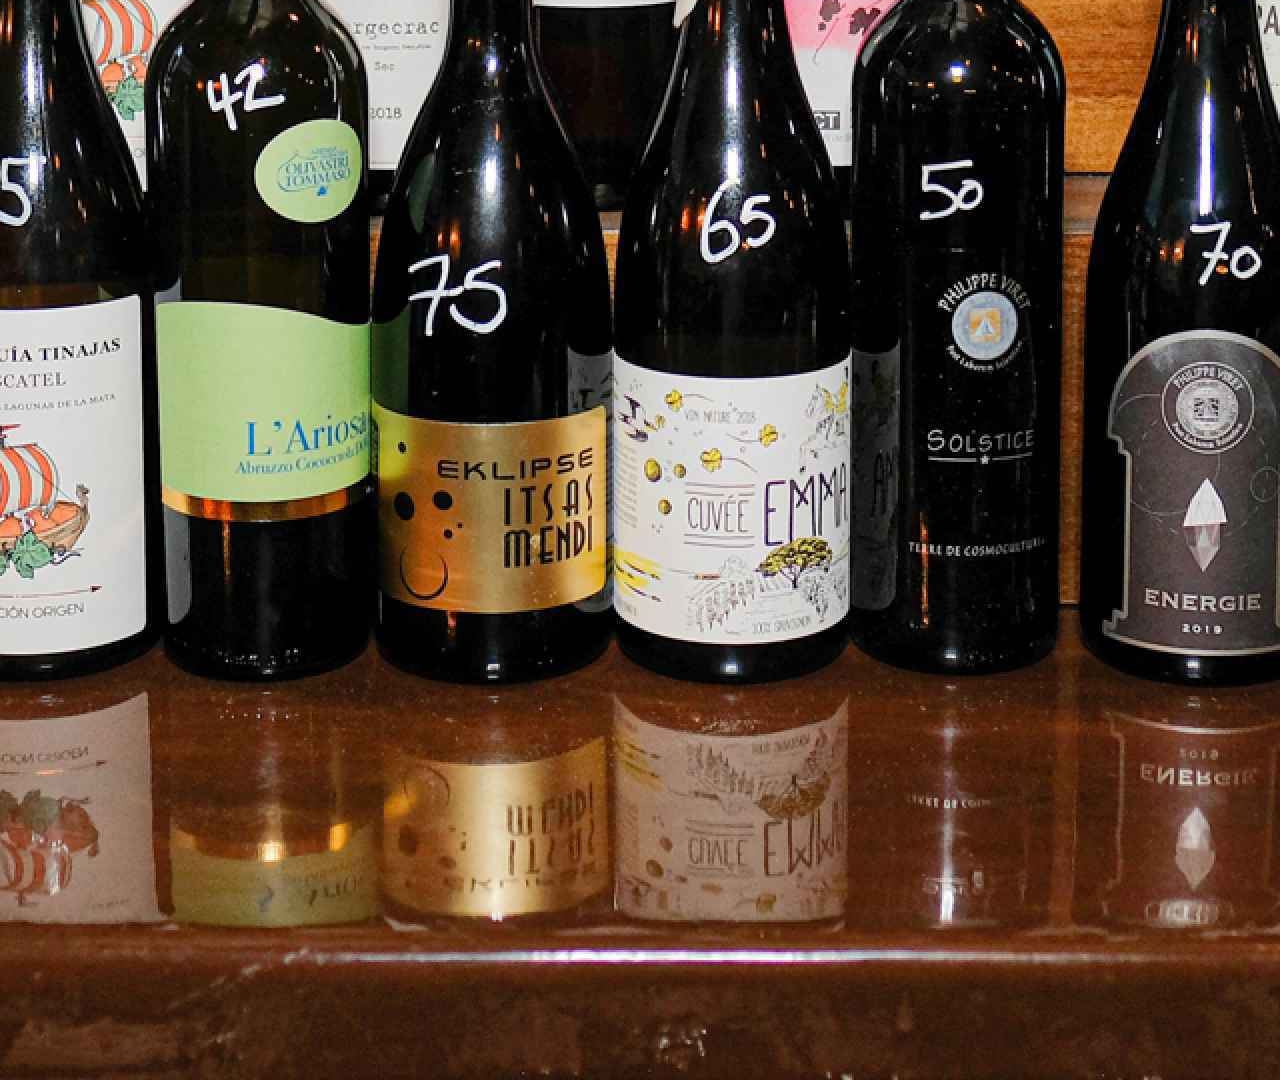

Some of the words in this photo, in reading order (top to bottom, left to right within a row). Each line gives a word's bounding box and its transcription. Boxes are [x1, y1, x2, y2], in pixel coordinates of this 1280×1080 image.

[351, 20, 441, 41] rgecrac
[207, 63, 285, 131] 42
[920, 159, 984, 220] 50
[700, 178, 776, 265] 65
[1190, 221, 1262, 287] 70
[408, 253, 508, 337] 75
[937, 273, 998, 312] PHILIPPE
[38, 337, 122, 362] TINAJAS
[436, 447, 593, 482] EKLIPSE
[927, 429, 1035, 454] SOLSTICE
[502, 474, 593, 527] ITSAS
[687, 493, 751, 534] CUVÉE
[763, 461, 850, 547] EMMA
[502, 515, 593, 569] MENDI
[31, 602, 85, 619] ORIGEN
[1144, 588, 1262, 613] ENERGIE
